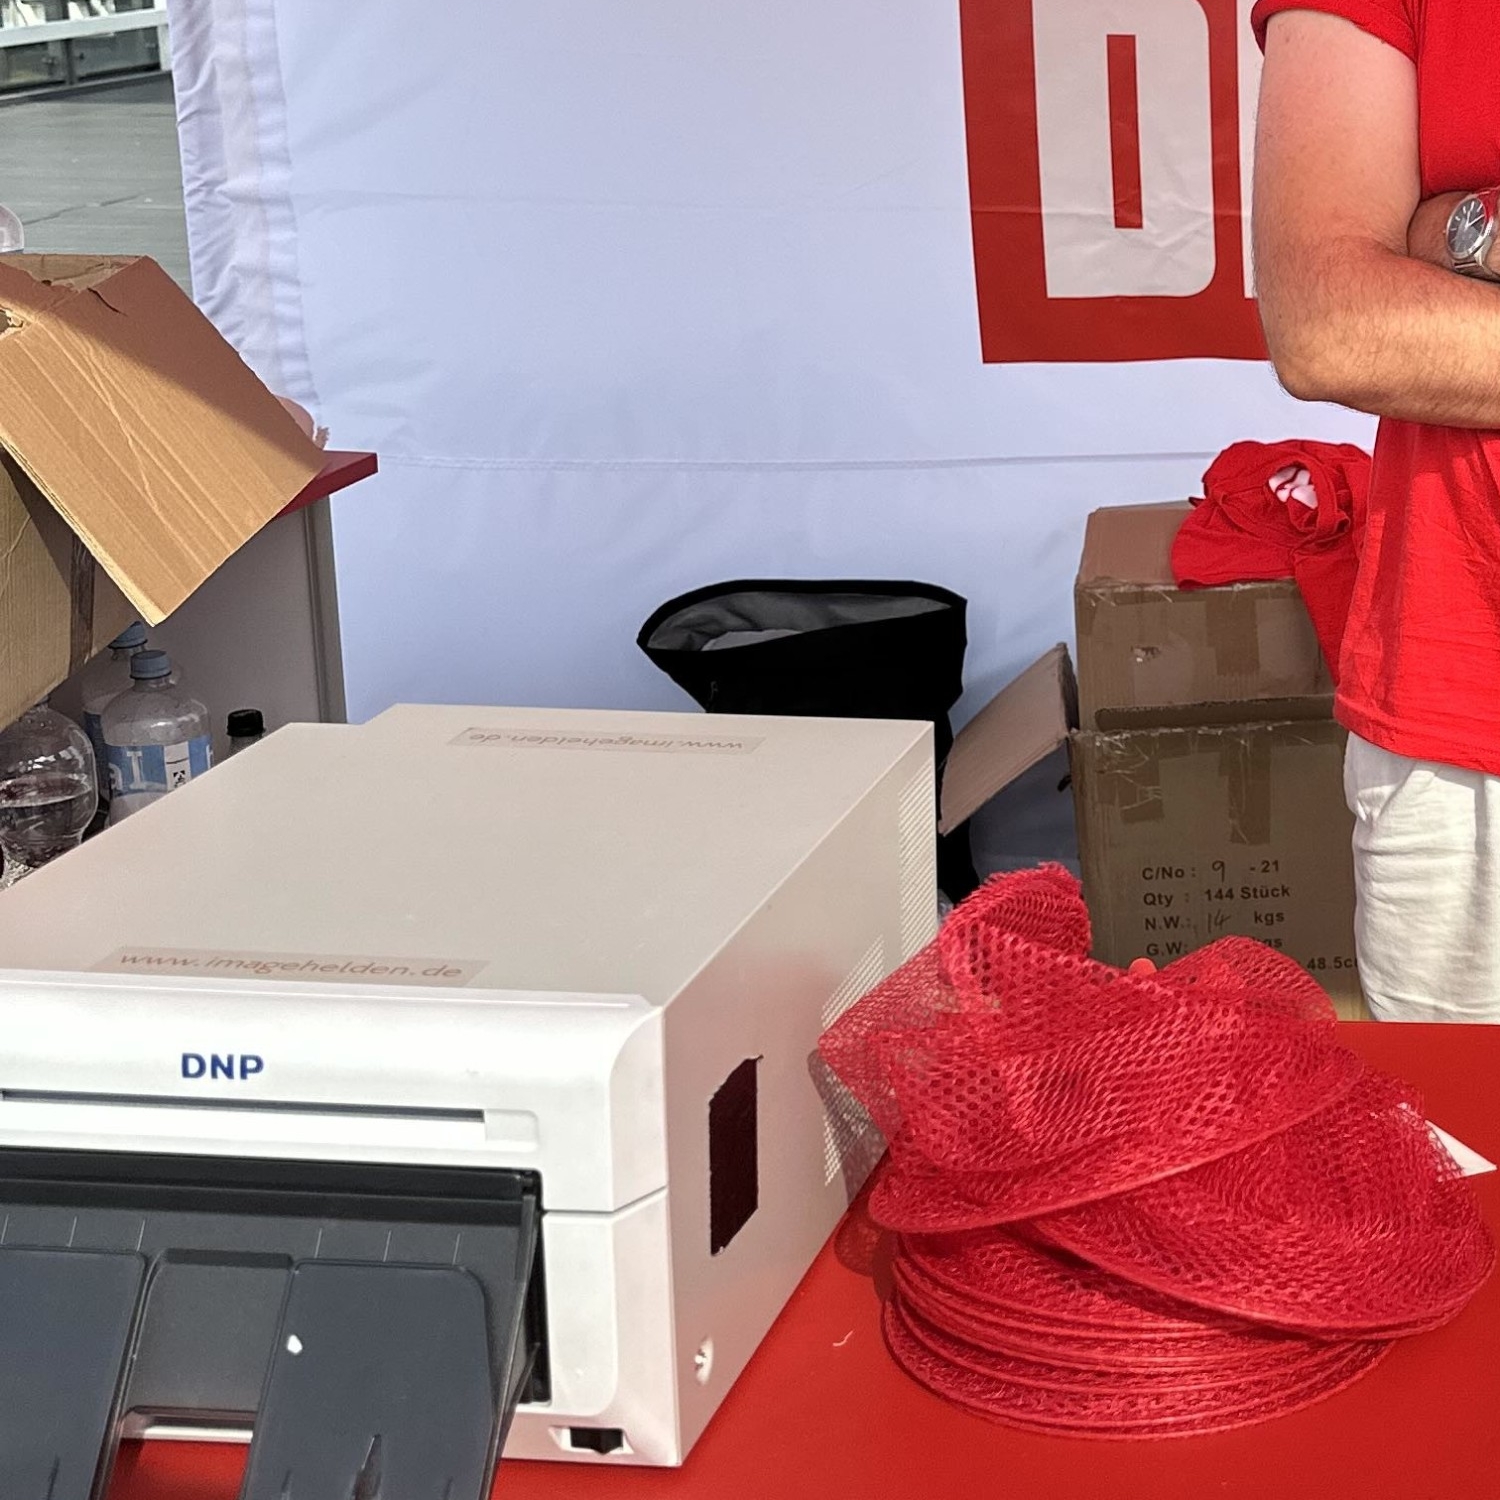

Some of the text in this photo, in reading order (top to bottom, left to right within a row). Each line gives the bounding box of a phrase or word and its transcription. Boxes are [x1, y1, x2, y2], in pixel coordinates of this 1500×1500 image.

[468, 732, 745, 750] www.imagehelden.de
[1260, 859, 1280, 874] 21
[1143, 892, 1174, 908] Qty
[1204, 887, 1235, 902] 144
[1240, 884, 1291, 901] Stück
[1253, 911, 1285, 926] kgs
[119, 953, 464, 980] www.imagehelden.de
[1306, 955, 1357, 971] 48.5c
[181, 1053, 264, 1080] DNP
